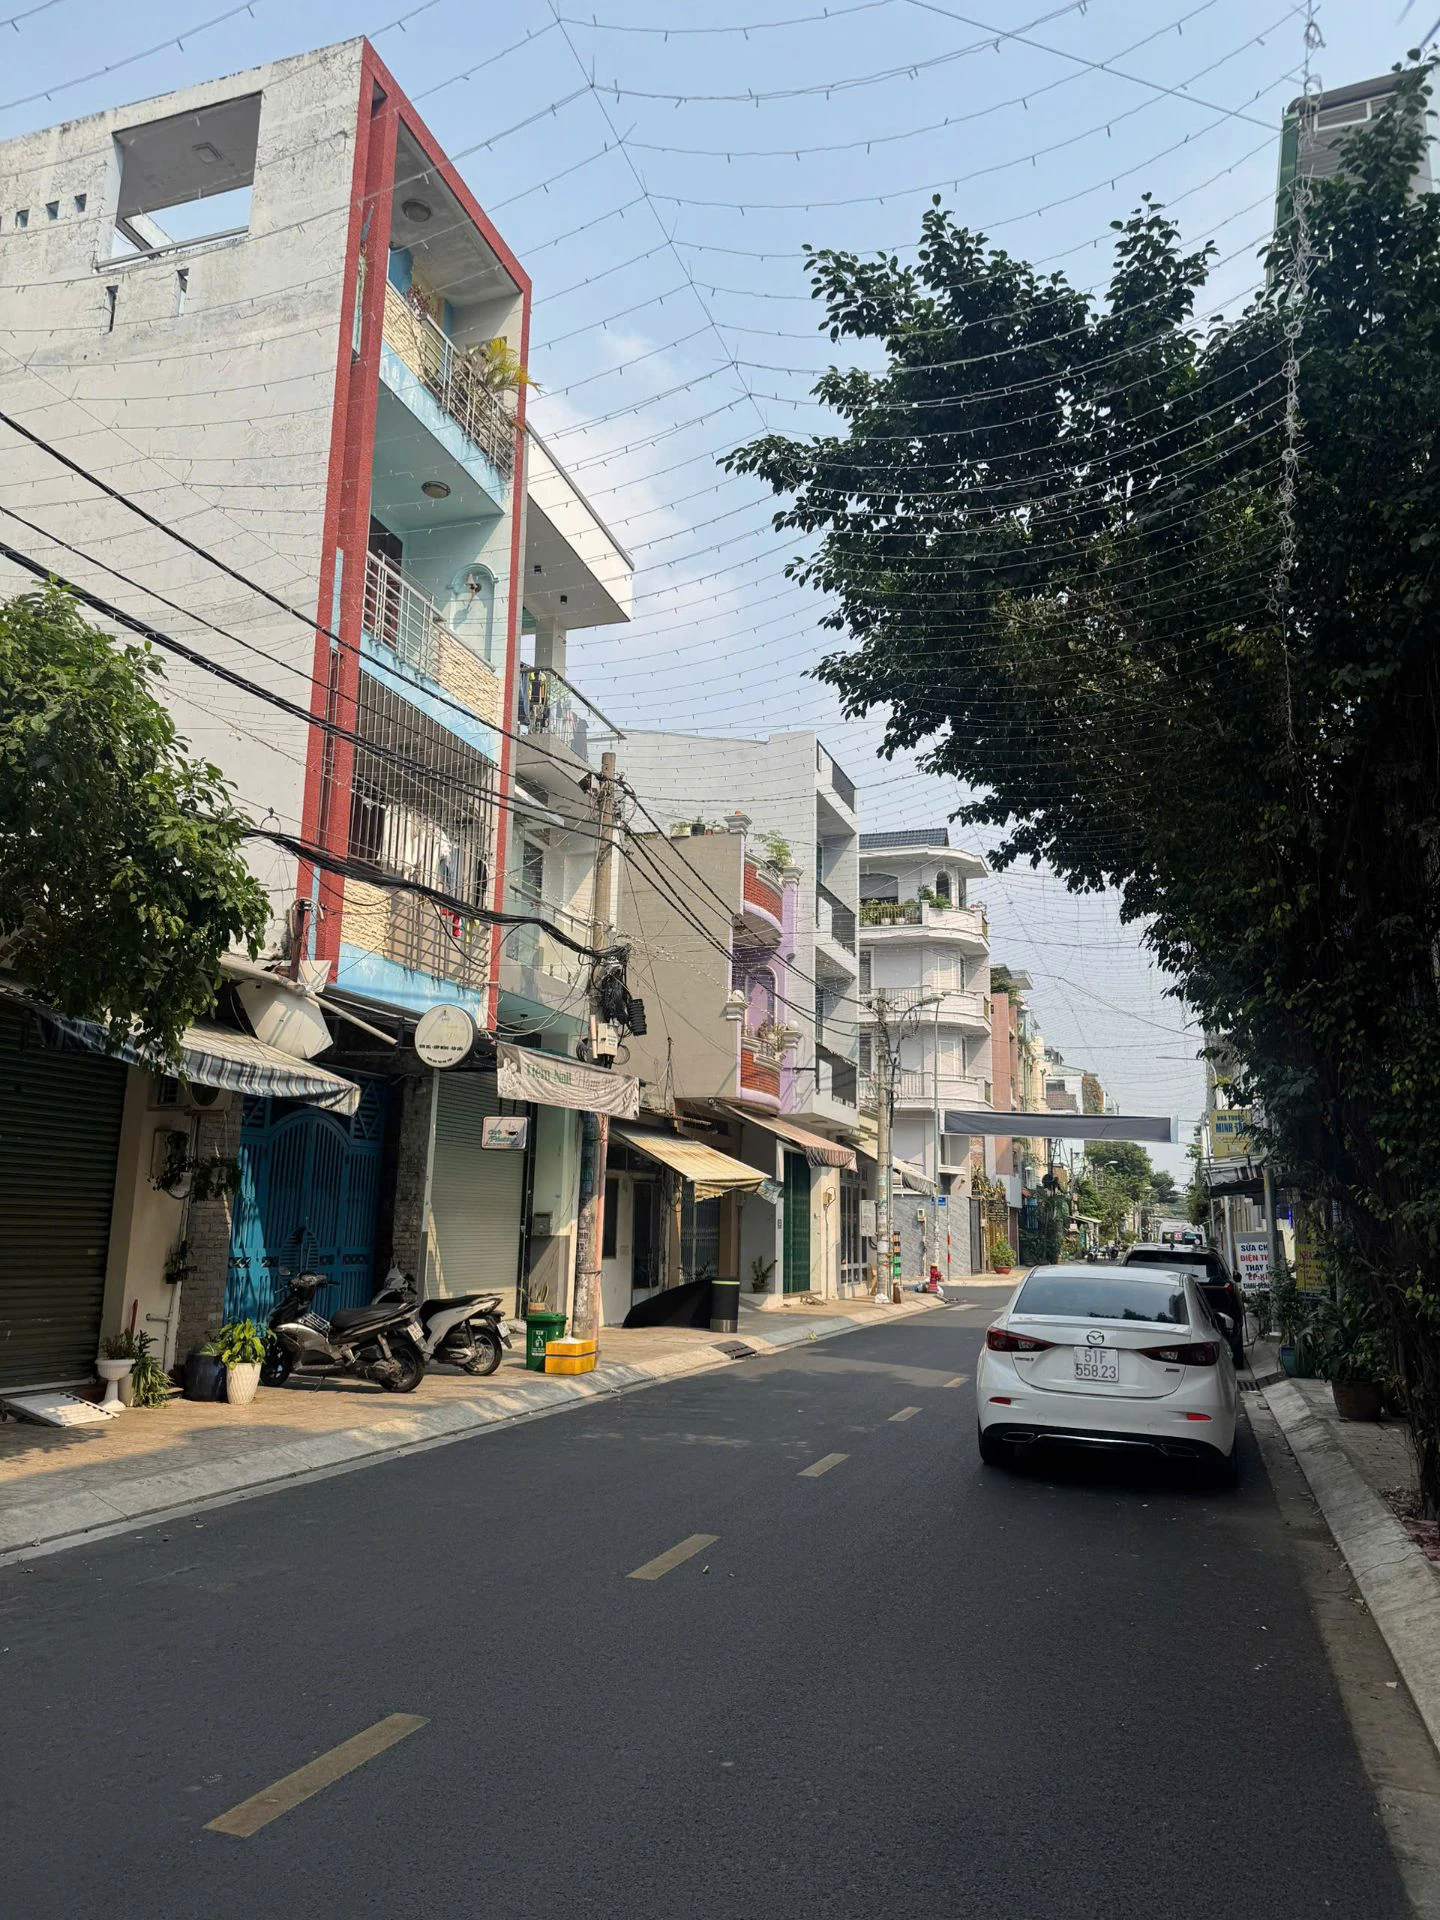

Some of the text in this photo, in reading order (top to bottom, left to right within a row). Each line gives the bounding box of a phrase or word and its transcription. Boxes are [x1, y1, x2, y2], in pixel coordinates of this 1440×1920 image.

[1215, 1122, 1233, 1133] MINH
[1240, 1242, 1268, 1252] SỬA CH
[1240, 1252, 1259, 1263] ĐIỆN
[1245, 1264, 1264, 1272] THAY
[1084, 1349, 1107, 1365] 51F
[1075, 1363, 1117, 1379] 558.23
